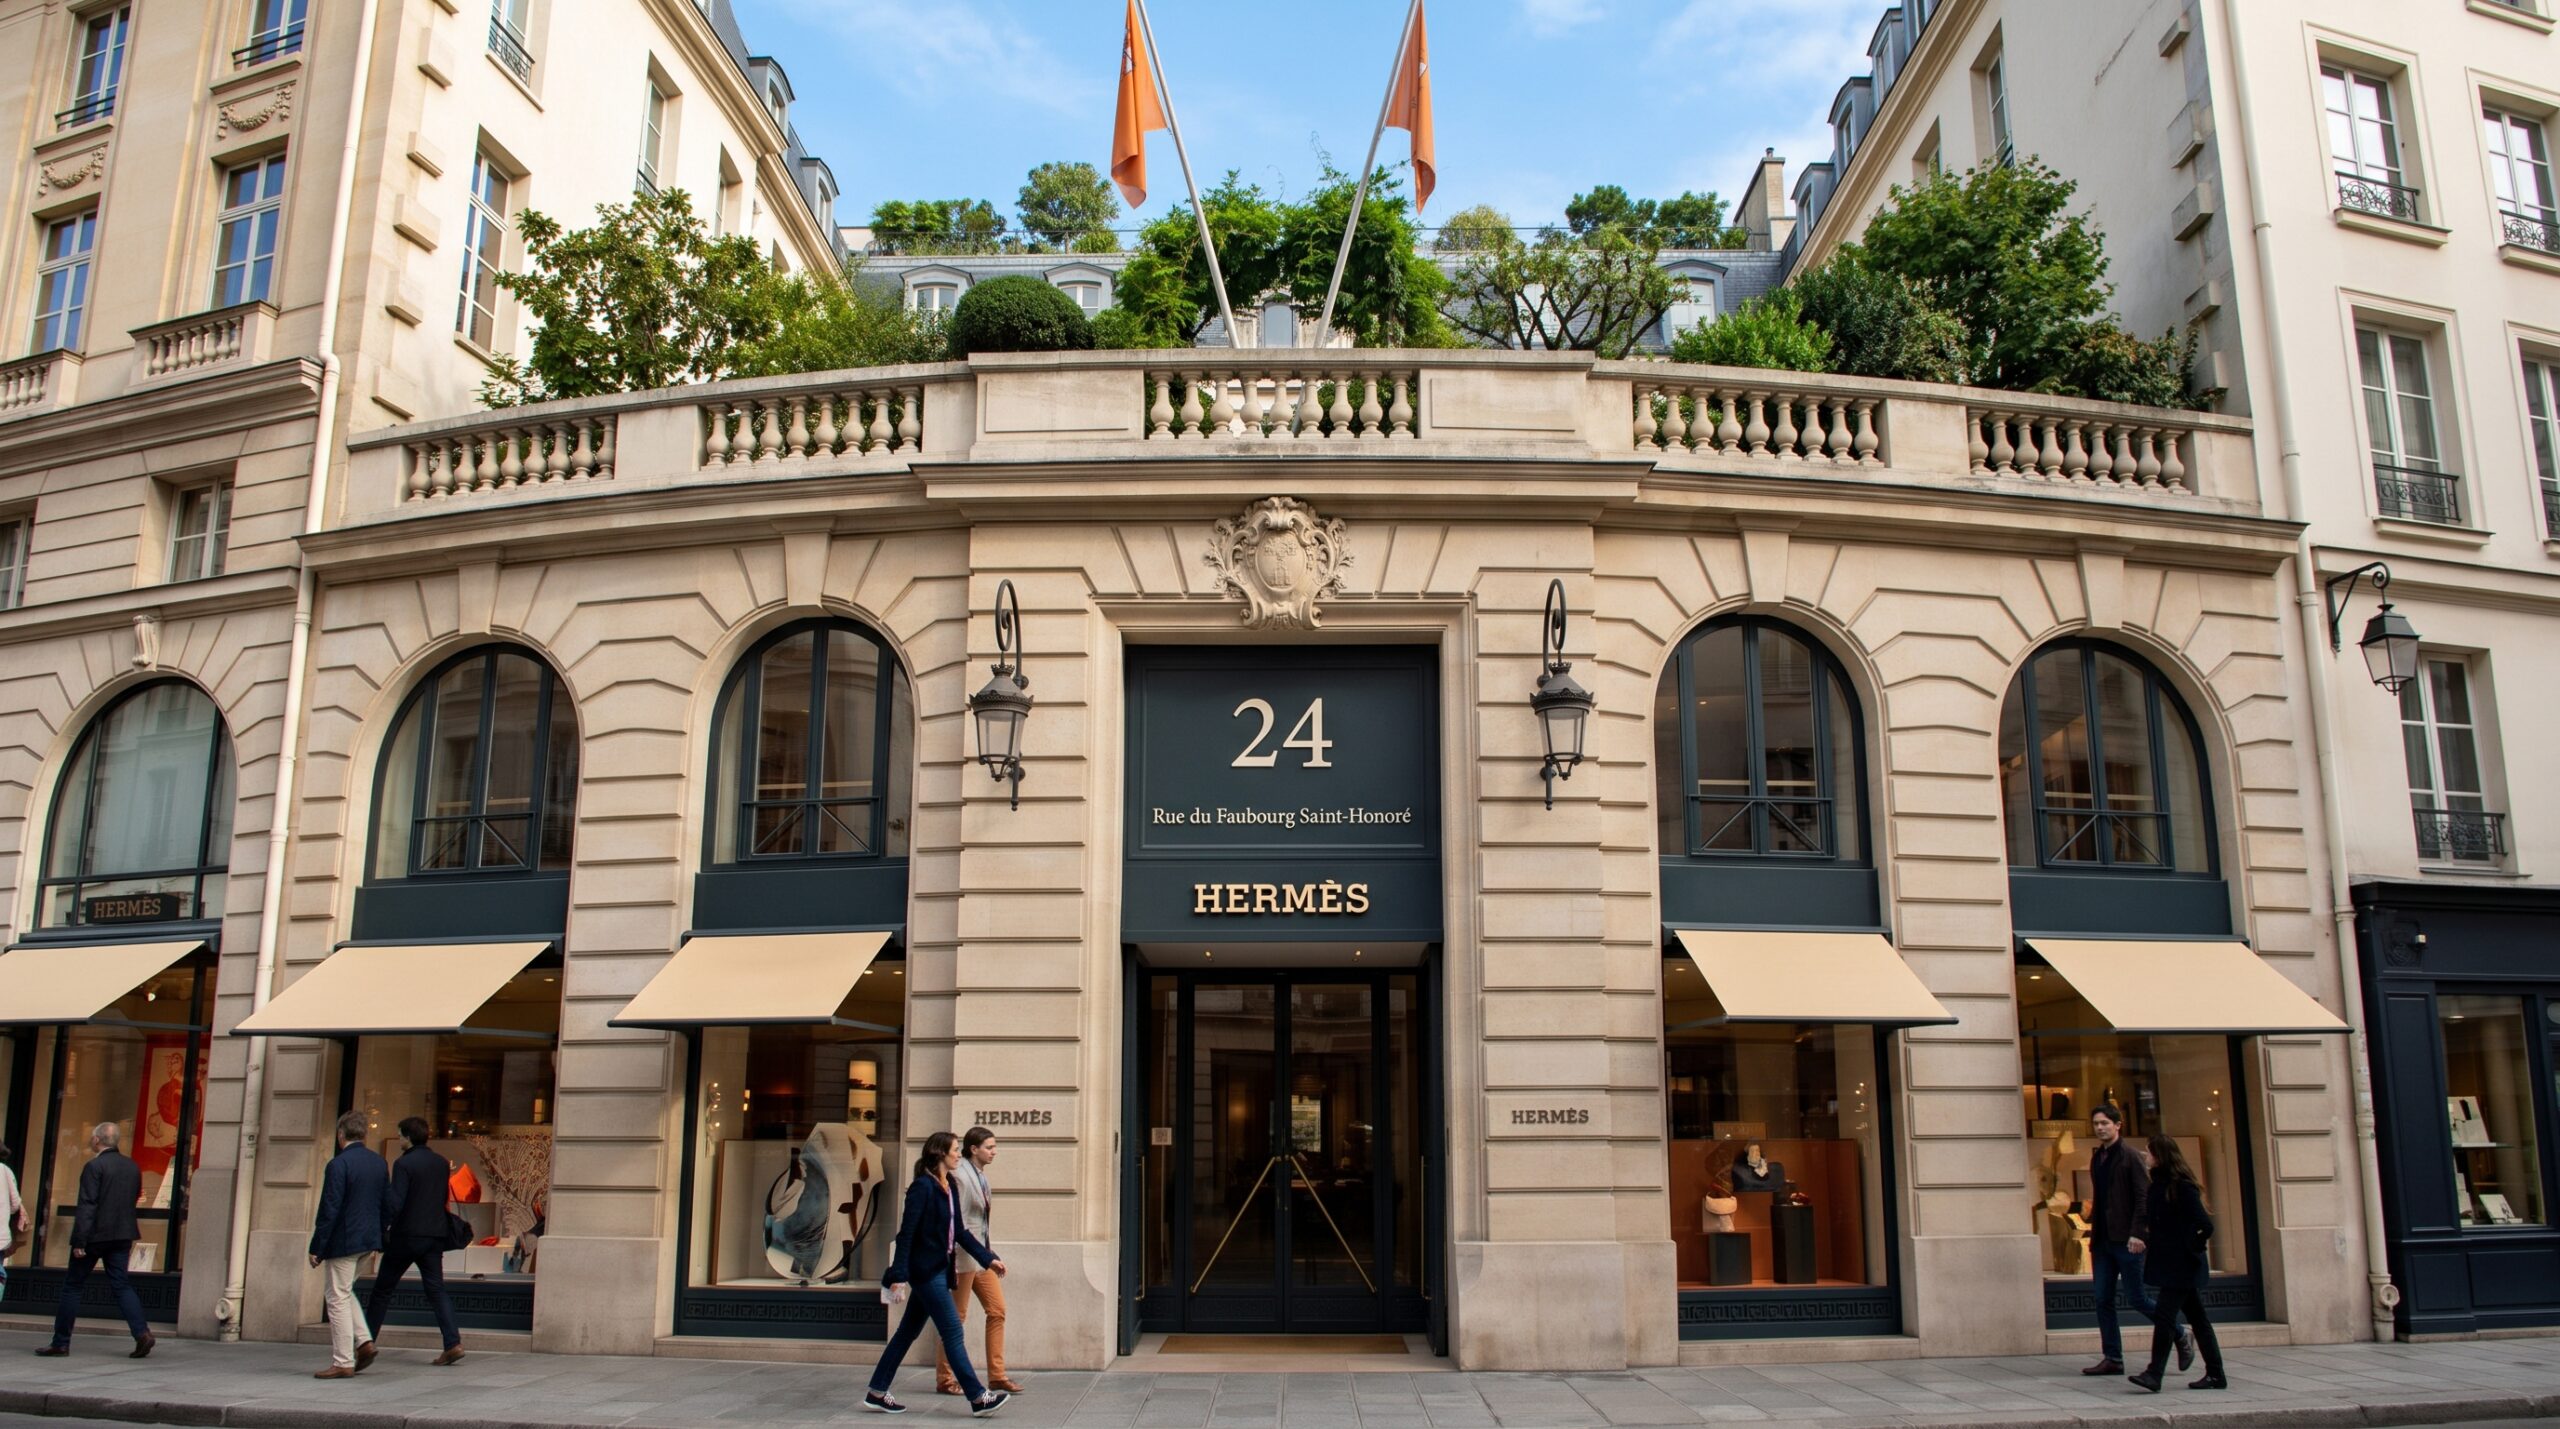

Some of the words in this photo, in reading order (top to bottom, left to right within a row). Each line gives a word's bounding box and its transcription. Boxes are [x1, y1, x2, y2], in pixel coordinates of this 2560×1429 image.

[1231, 697, 1333, 768] 24
[1152, 808, 1185, 825] Rue
[1190, 807, 1211, 825] du
[1216, 807, 1296, 829] Faubourg
[1300, 807, 1412, 825] Saint-Honoré
[1194, 880, 1370, 914] HERMÈS
